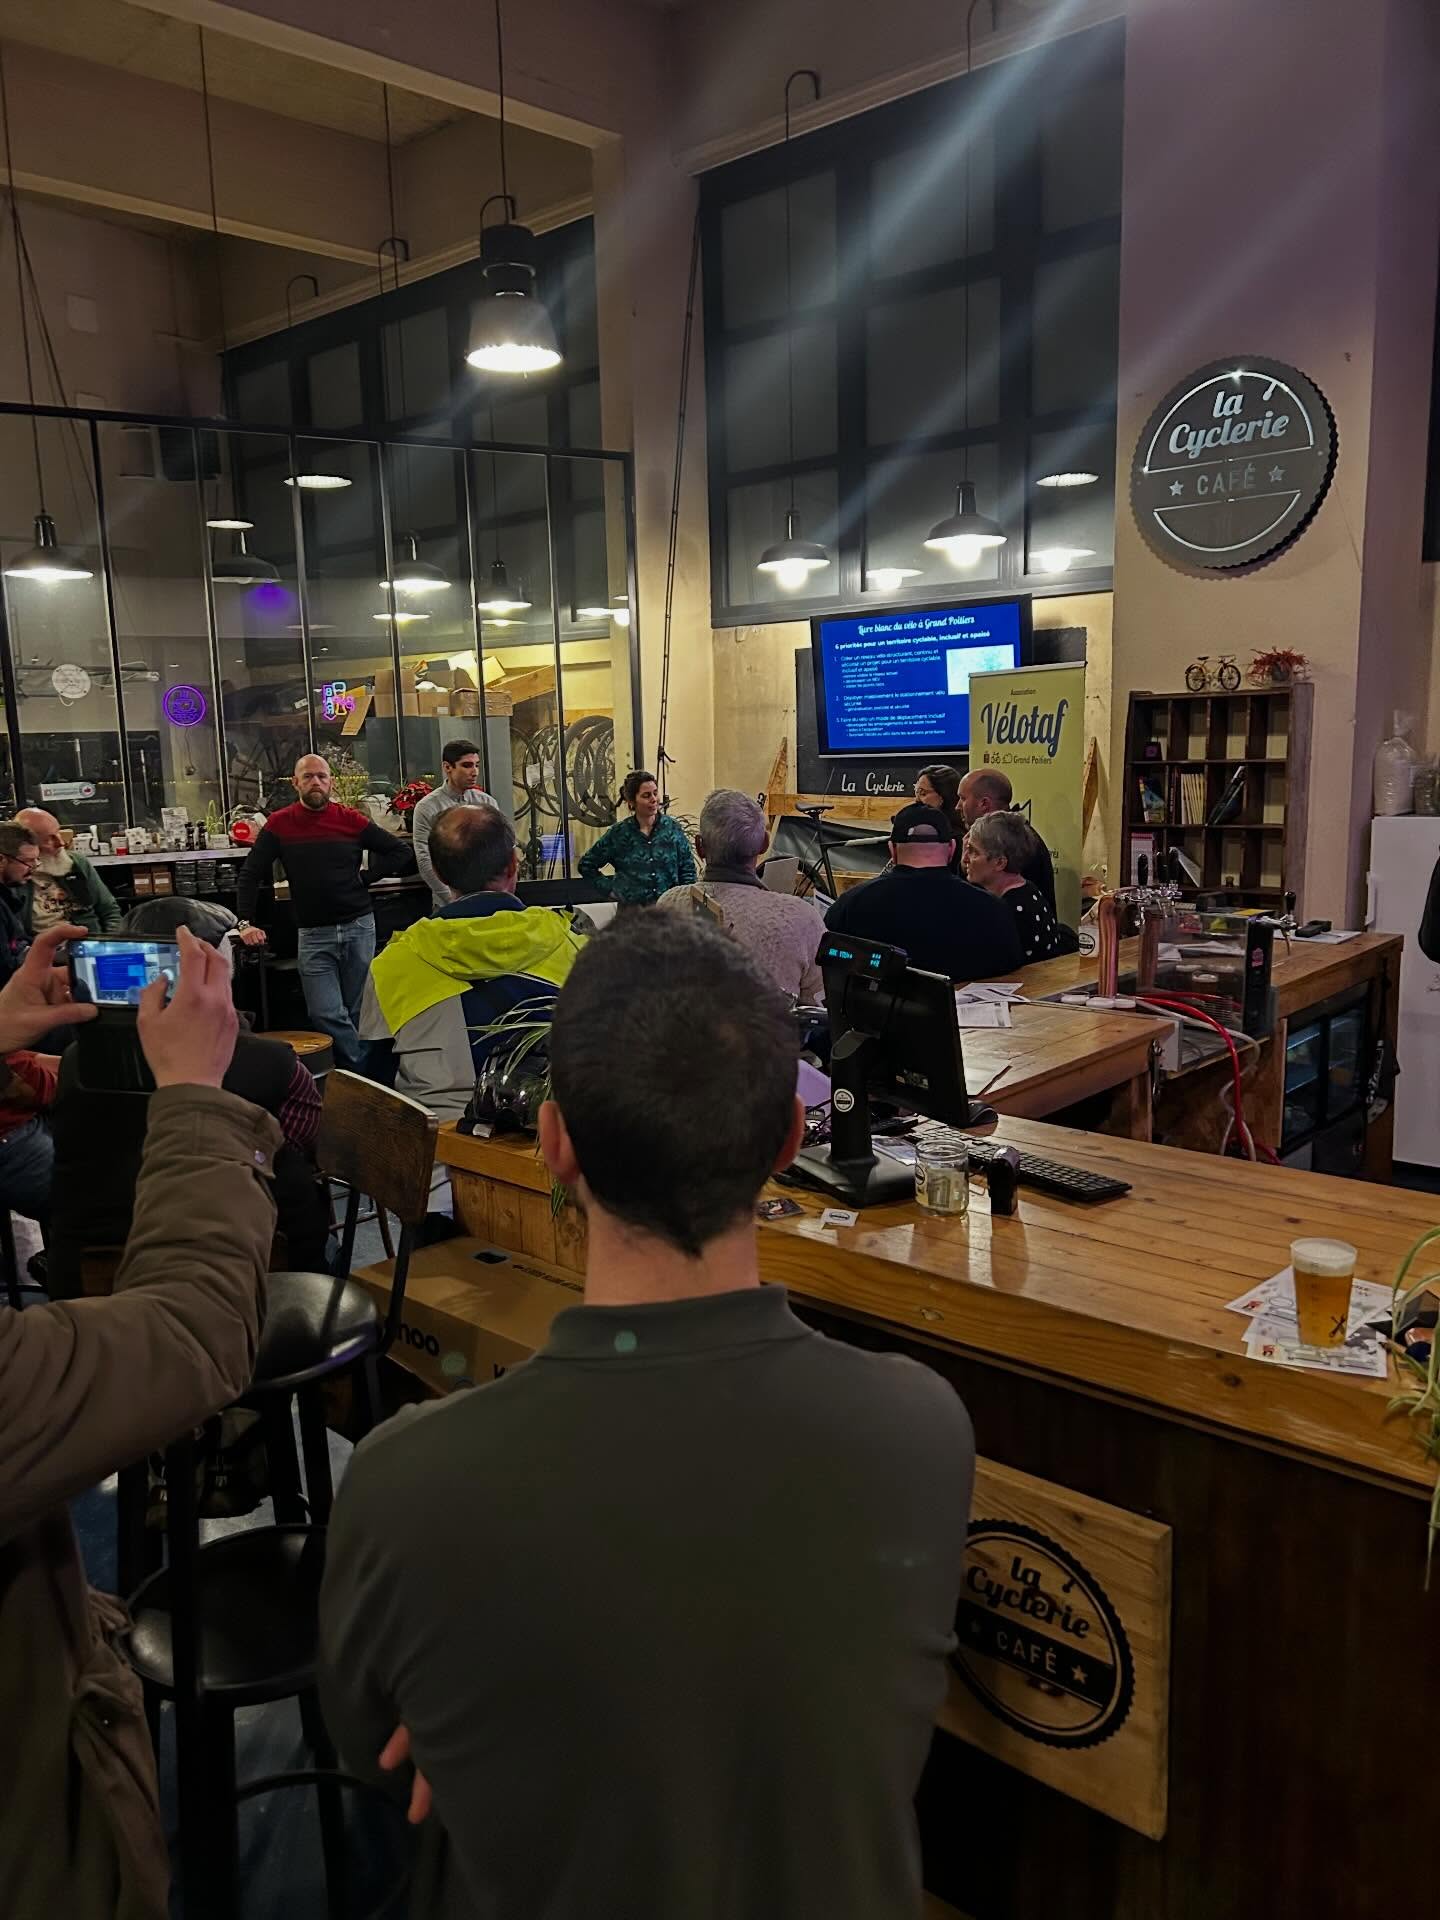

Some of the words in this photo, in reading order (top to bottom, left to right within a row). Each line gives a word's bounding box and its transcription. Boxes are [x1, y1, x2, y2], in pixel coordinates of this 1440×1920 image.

[1212, 390, 1244, 418] la
[1168, 410, 1290, 459] Cyclerie
[1196, 462, 1257, 496] CAFÉ
[874, 624, 892, 632] blanc
[893, 622, 902, 630] du
[904, 620, 917, 629] vélo
[924, 618, 947, 629] Grand
[948, 616, 976, 625] Poitiers
[980, 698, 1069, 758] Vélotaf
[1014, 756, 1030, 764] Grand
[1032, 756, 1052, 764] Poitiers
[841, 774, 856, 792] La
[865, 772, 905, 794] Cyclerie
[1010, 1557, 1041, 1587] la
[967, 1566, 1090, 1638] Cyclerie
[998, 1632, 1058, 1674] CAFÉ
